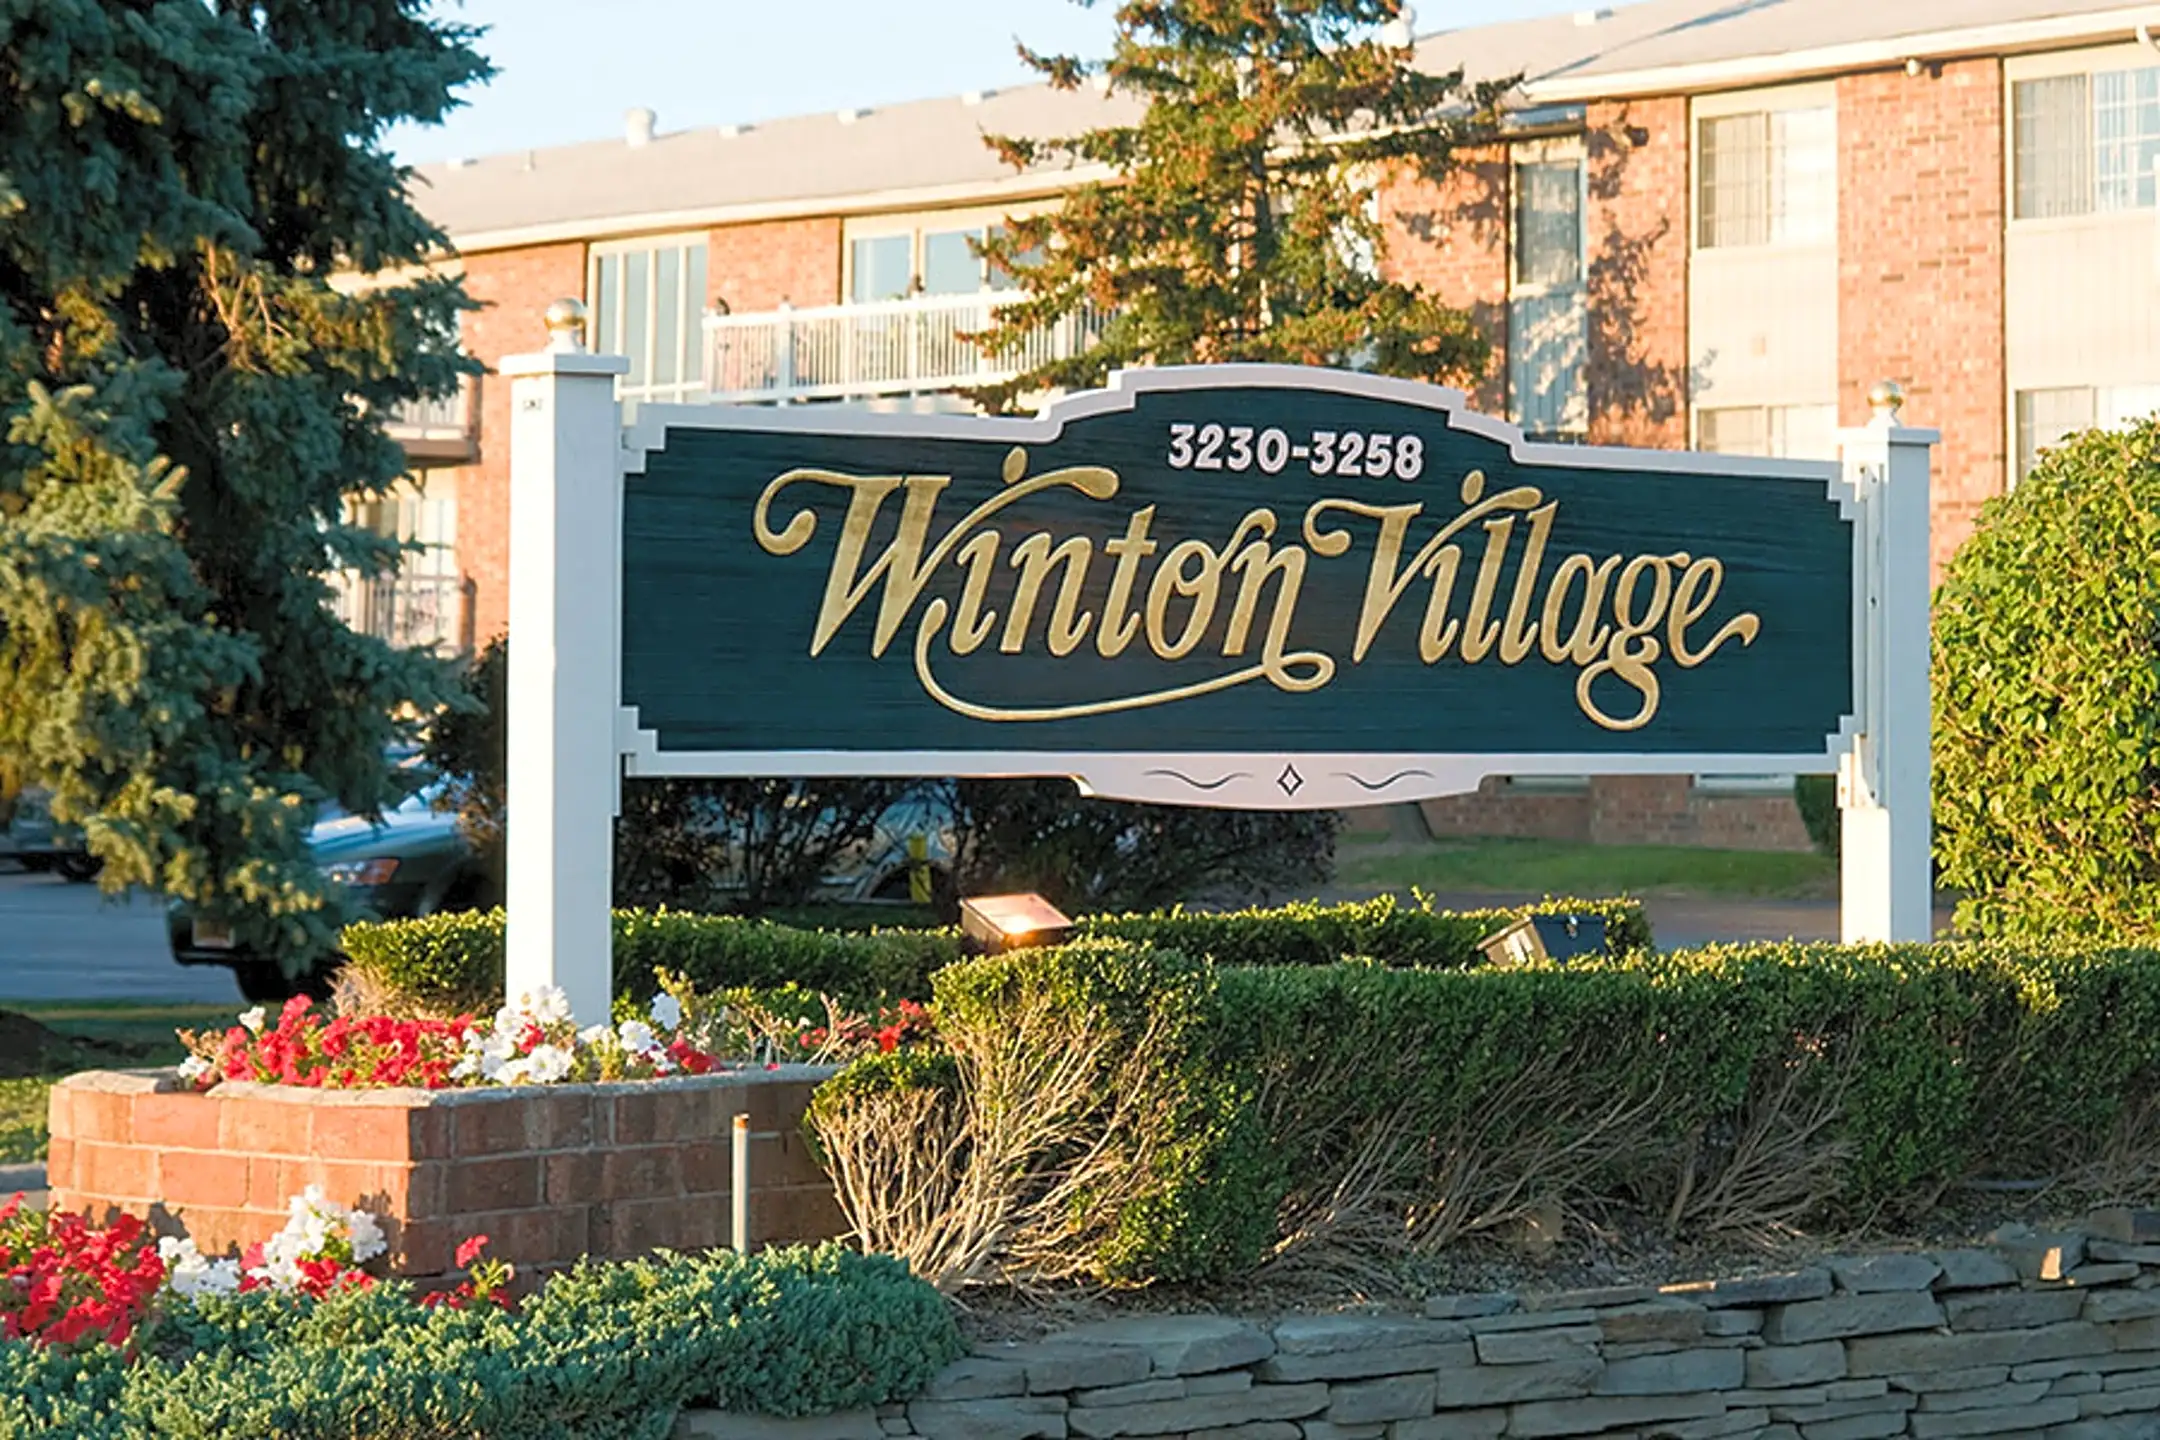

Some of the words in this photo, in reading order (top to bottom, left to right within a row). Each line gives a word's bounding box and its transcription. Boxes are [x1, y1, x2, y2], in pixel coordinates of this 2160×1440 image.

[1168, 423, 1423, 480] 3230-3258
[753, 446, 1336, 722] Winton
[1302, 469, 1761, 731] Village
